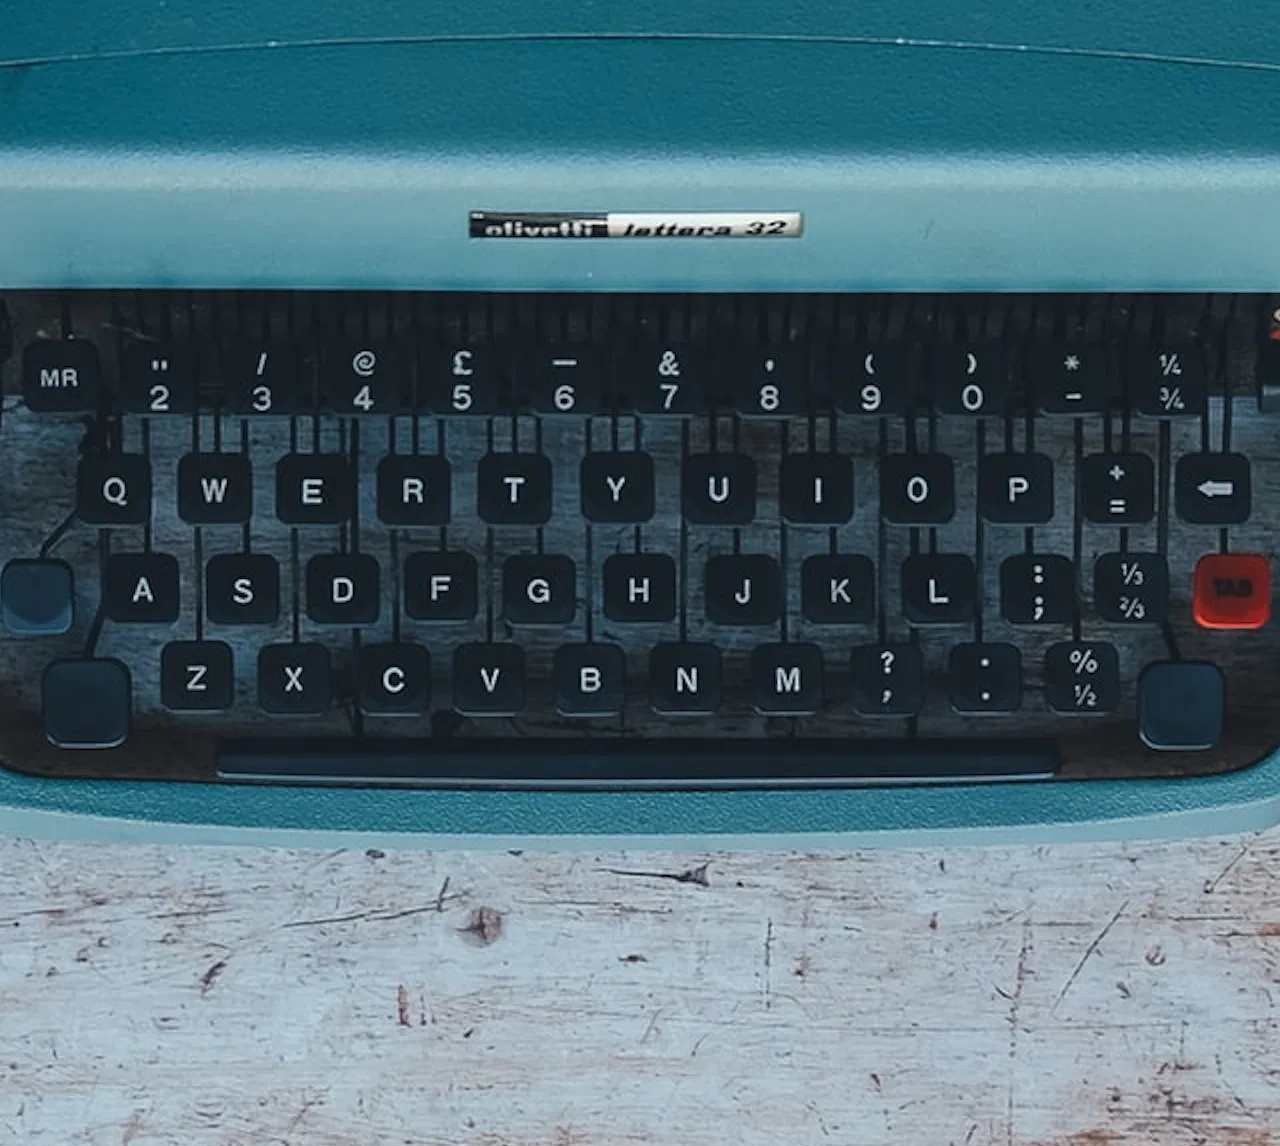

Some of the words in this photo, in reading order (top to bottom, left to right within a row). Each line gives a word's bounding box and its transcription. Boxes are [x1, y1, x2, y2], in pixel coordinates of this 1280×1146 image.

[484, 220, 594, 237] olivetti
[623, 223, 733, 237] lettera
[745, 219, 788, 236] 32
[257, 353, 267, 375] /
[353, 351, 375, 375] @
[453, 351, 472, 375] £
[658, 351, 680, 376] &
[865, 355, 873, 374] (
[968, 354, 977, 373] )
[41, 369, 77, 386] MR
[150, 385, 168, 410] 2
[253, 386, 272, 411] 3
[354, 386, 373, 410] 4
[453, 385, 471, 410] 5
[555, 385, 574, 410] 6
[661, 385, 678, 410] 7
[760, 385, 779, 410] 8
[862, 385, 880, 410] 9
[963, 385, 982, 410] 0
[104, 477, 127, 505] Q
[202, 479, 227, 503] W
[302, 479, 323, 504] E
[403, 479, 423, 503] R
[504, 477, 525, 503] T
[606, 477, 626, 502] Y
[709, 477, 728, 502] U
[815, 478, 822, 503] I
[907, 477, 927, 503] O
[1009, 477, 1028, 503] P
[133, 577, 153, 603] A
[233, 578, 253, 604] S
[333, 578, 353, 603] D
[431, 576, 451, 601] F
[527, 579, 550, 603] G
[629, 578, 649, 603] H
[735, 579, 750, 604] J
[831, 579, 851, 604] K
[929, 579, 948, 604] L
[881, 651, 894, 674] ?
[1069, 649, 1098, 674] %
[187, 666, 207, 691] Z
[285, 667, 303, 692] X
[383, 667, 404, 693] C
[480, 668, 500, 692] V
[581, 667, 601, 693] B
[677, 667, 697, 693] N
[776, 667, 800, 693] M
